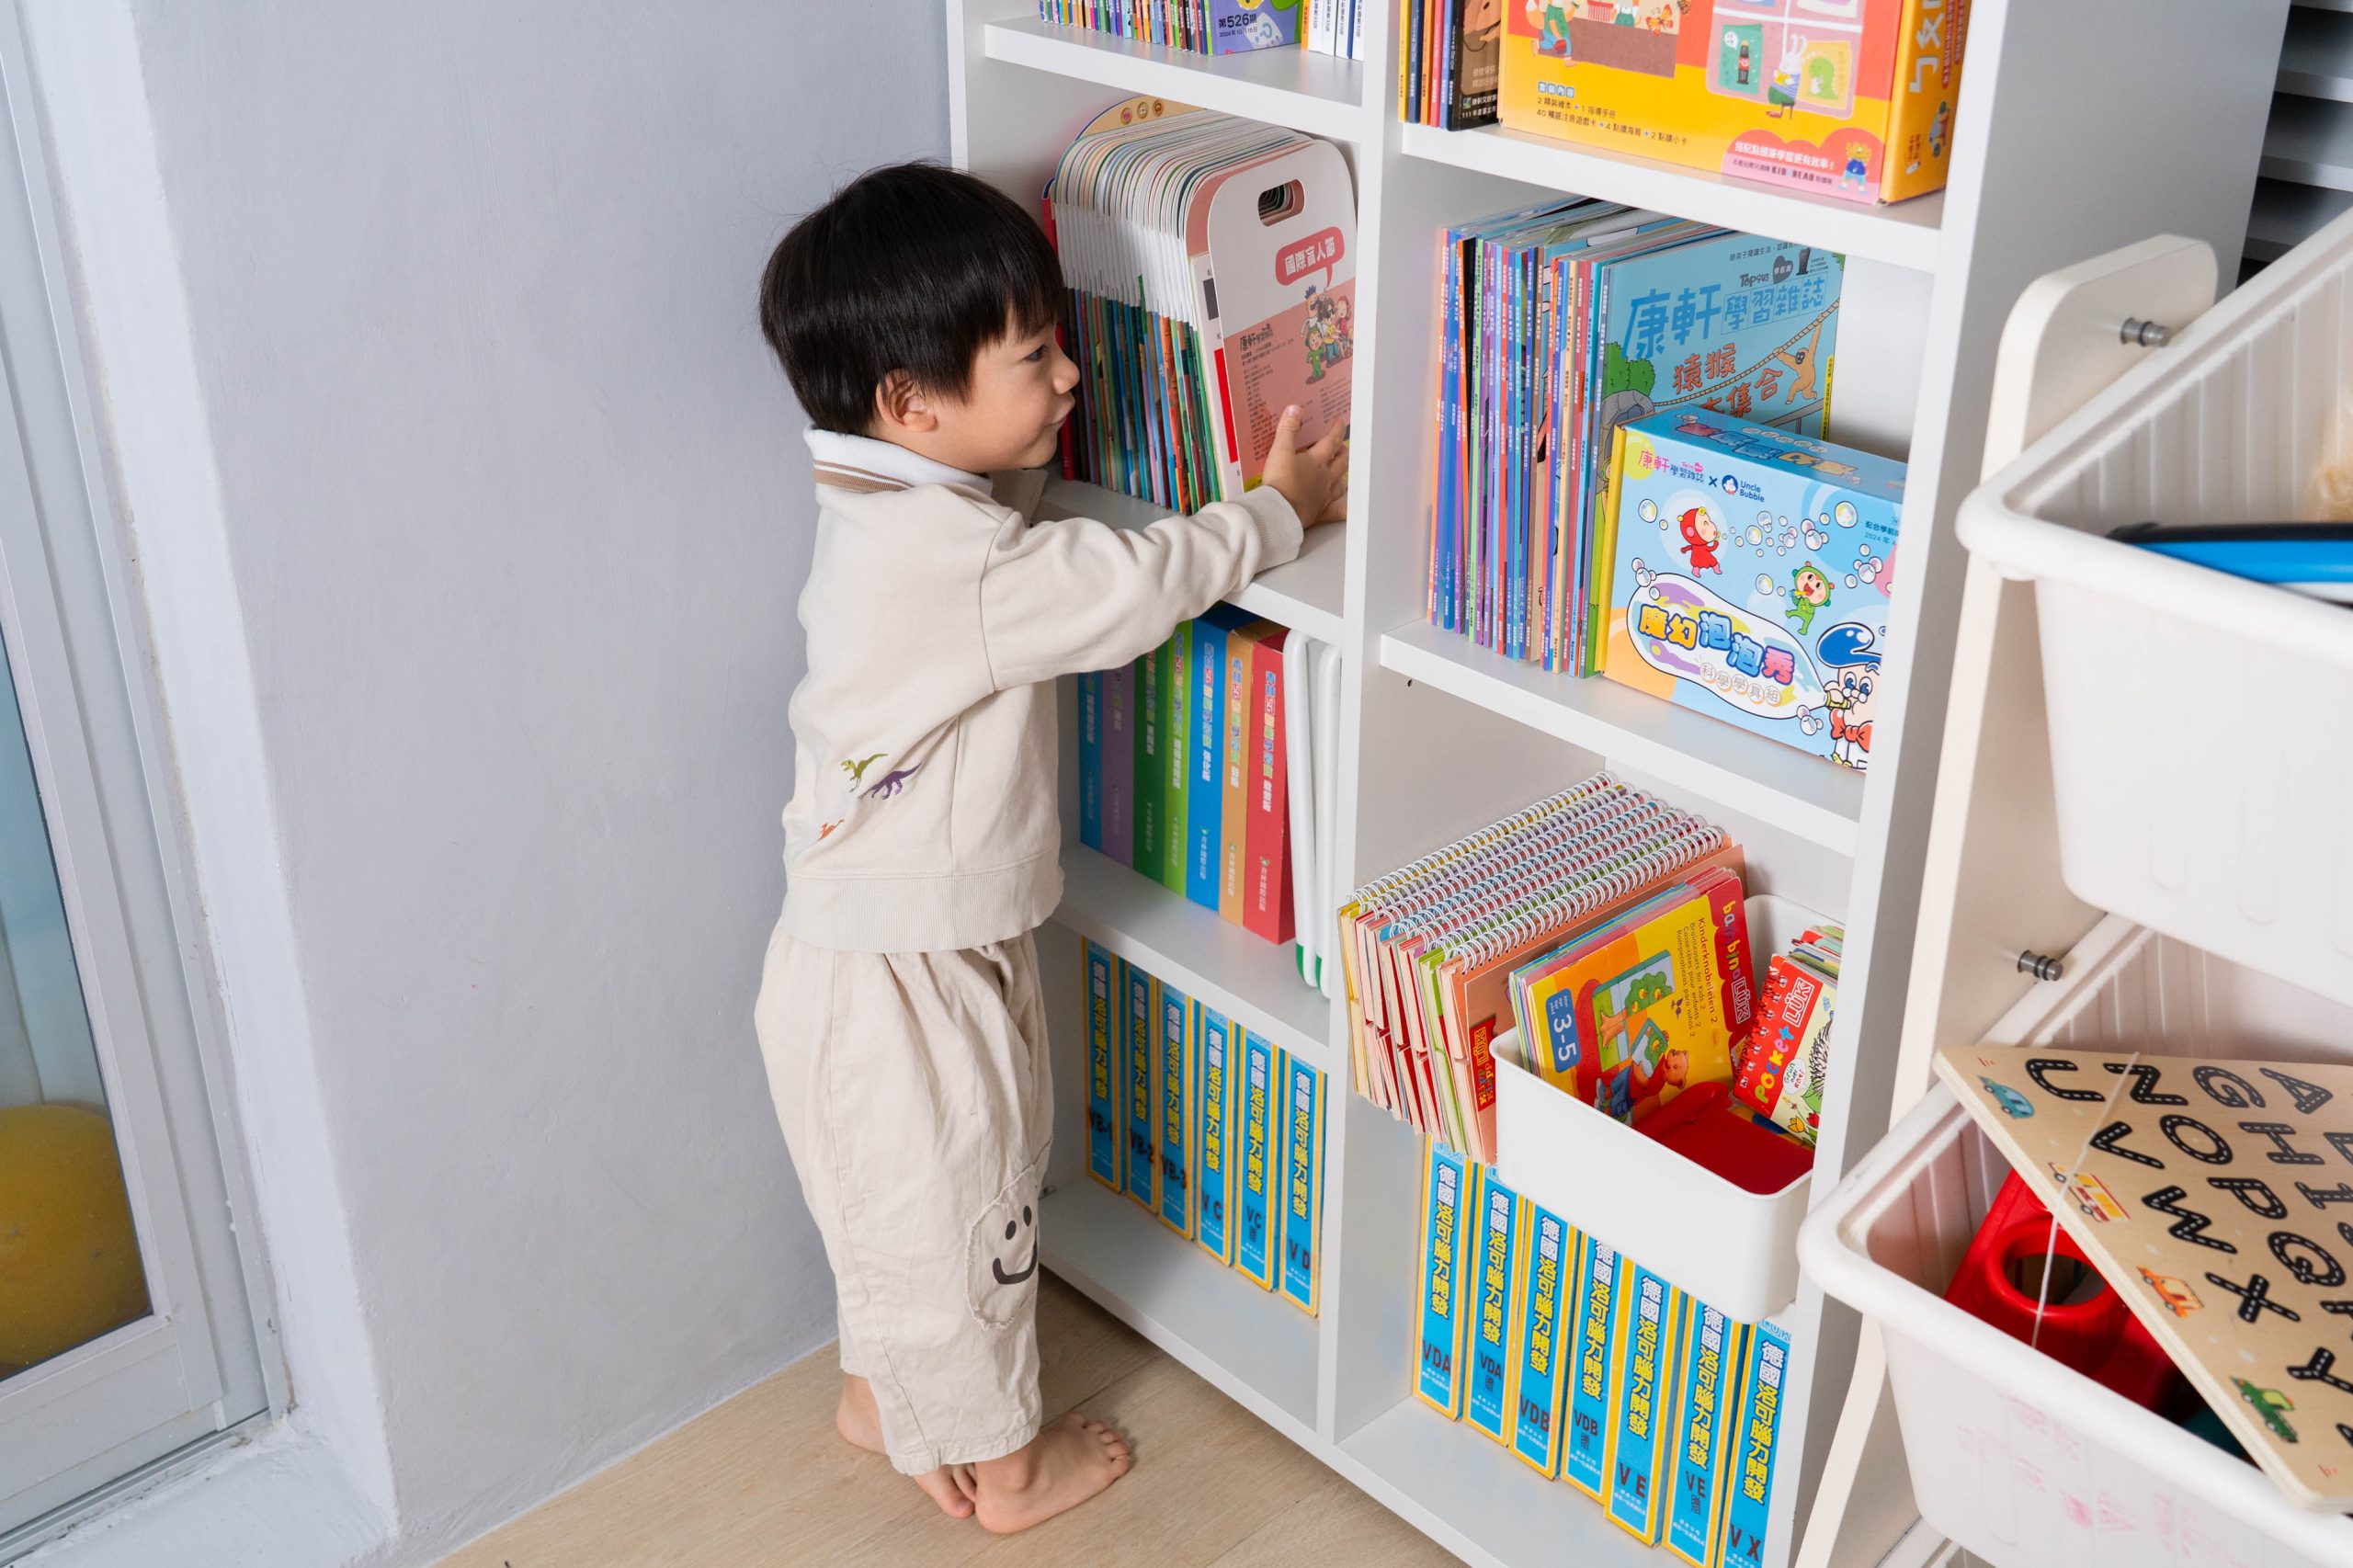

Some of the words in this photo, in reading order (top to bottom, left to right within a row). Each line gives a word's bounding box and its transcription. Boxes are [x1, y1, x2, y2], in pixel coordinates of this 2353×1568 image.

[1218, 13, 1257, 28] 第526期
[1284, 235, 1336, 276] 國際盲人節
[1672, 342, 1736, 395] 猿猴
[1739, 489, 1765, 502] Bubble
[1740, 480, 1761, 493] Uncle
[1638, 603, 1795, 686] 魔幻泡泡秀
[1700, 662, 1780, 706] 科學學具組
[1677, 929, 1687, 986] Rompecabezas
[1689, 922, 1700, 968] Brainteasers
[1699, 917, 1716, 1014] Kinderknobeleien
[1711, 1017, 1718, 1025] 2
[1688, 971, 1696, 989] pour
[1731, 976, 1751, 1025] LÜK
[1781, 976, 1815, 1028] LÜK
[1473, 1027, 1489, 1066] LÜK
[1553, 1014, 1577, 1062] 3-5
[1206, 1027, 1222, 1174] 德國洛可腦力開發
[2192, 1065, 2266, 1108] G
[2237, 1120, 2325, 1165] H
[2258, 1067, 2334, 1115] A
[1247, 1047, 1266, 1196] 德國洛可腦力開發
[1292, 1070, 1312, 1221] 德國洛可腦力開發
[2025, 1058, 2106, 1102] U
[2089, 1120, 2165, 1169] V
[2142, 1185, 2238, 1254] W
[2204, 1273, 2302, 1324] X
[2103, 1062, 2189, 1106] N
[2159, 1114, 2234, 1165] O
[2207, 1176, 2289, 1220] P
[2267, 1231, 2347, 1287] Q
[1429, 1163, 1459, 1320] 德國洛可腦力開發
[1481, 1188, 1509, 1347] 德國洛可腦力開發
[1529, 1215, 1562, 1378] 德國洛可腦力開發
[1582, 1238, 1616, 1403] 德國洛可腦力開發
[1423, 1339, 1451, 1377] VDA
[1480, 1351, 1502, 1381] VDA
[1628, 1276, 1664, 1440] 德國洛可腦力開發
[1520, 1393, 1551, 1433] VDB
[1687, 1306, 1725, 1471] 德國洛可腦力開發
[1574, 1408, 1598, 1437] VDB
[1741, 1339, 1786, 1506] 德國洛可腦力開發
